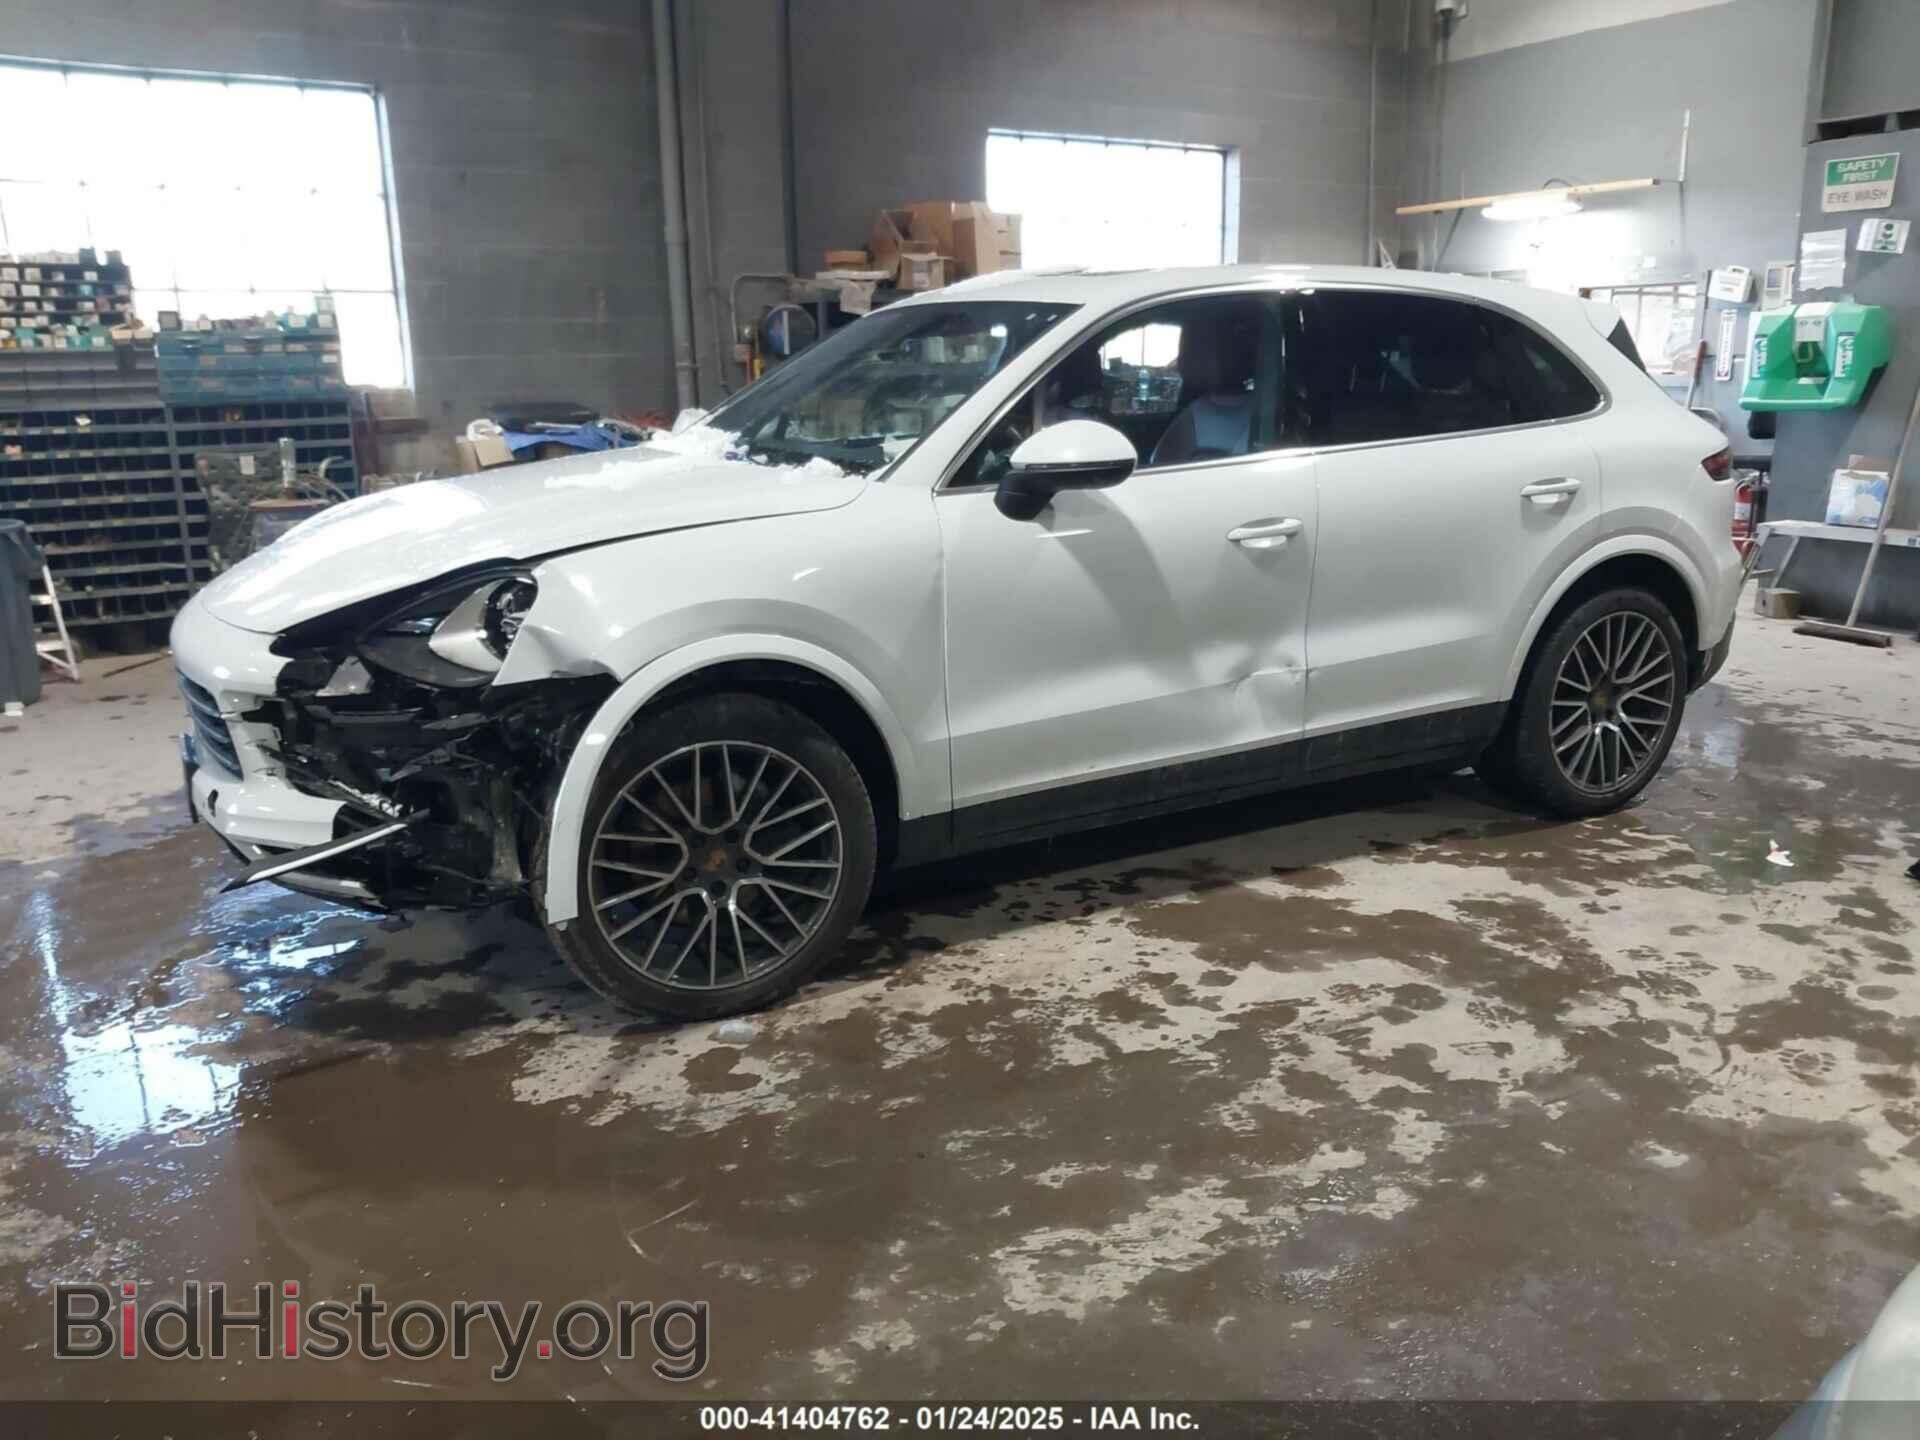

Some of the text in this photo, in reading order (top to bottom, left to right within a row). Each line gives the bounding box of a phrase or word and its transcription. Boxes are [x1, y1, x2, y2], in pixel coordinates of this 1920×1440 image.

[1837, 158, 1888, 173] SAFETY
[1842, 170, 1879, 183] FIRST
[1827, 188, 1888, 204] EYE WASH
